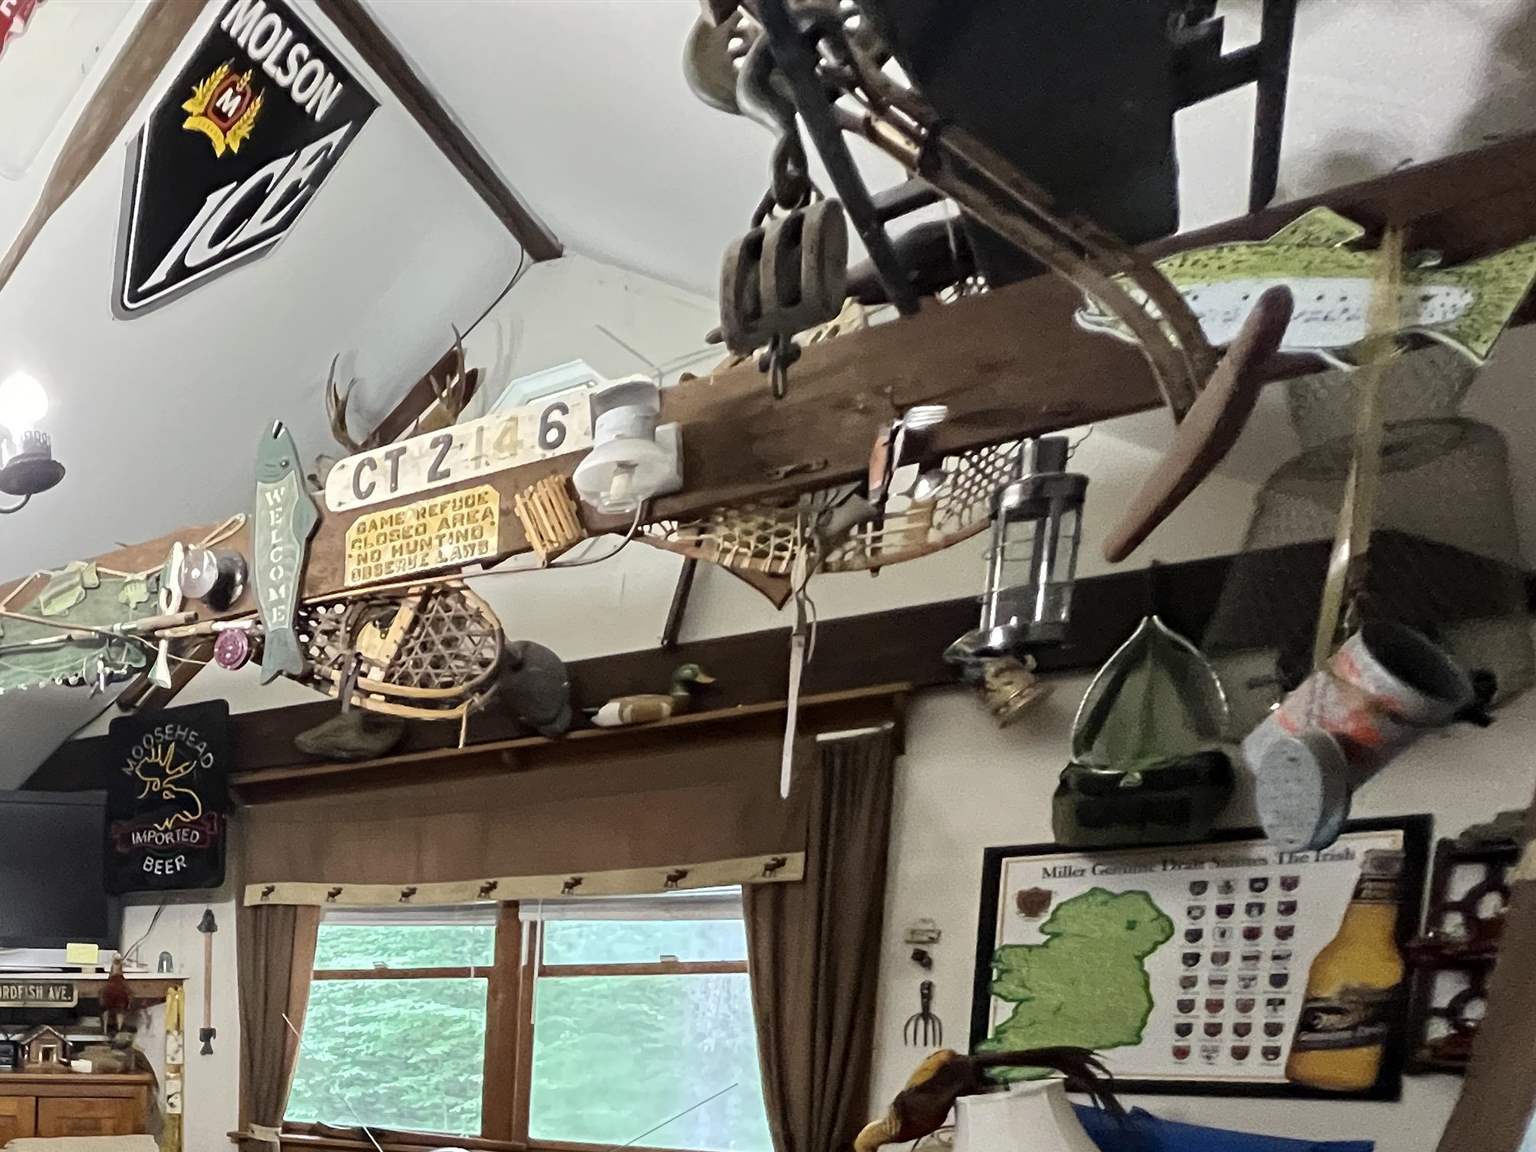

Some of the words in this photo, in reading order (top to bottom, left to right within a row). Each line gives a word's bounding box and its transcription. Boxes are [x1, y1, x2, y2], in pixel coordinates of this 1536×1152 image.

[221, 0, 343, 122] MOLSON
[216, 88, 242, 118] M
[136, 120, 353, 293] ICE
[352, 446, 407, 501] CT
[350, 522, 428, 551] CLOSED
[436, 506, 496, 532] AREA
[356, 510, 405, 536] GAME
[265, 485, 286, 625] WELCOME
[356, 549, 382, 567] NO
[121, 724, 214, 776] MOOSEHEAD
[131, 827, 201, 846] IMPORTED
[142, 854, 188, 876] BEER
[1041, 865, 1088, 880] Miller
[48, 985, 73, 1001] AVE.
